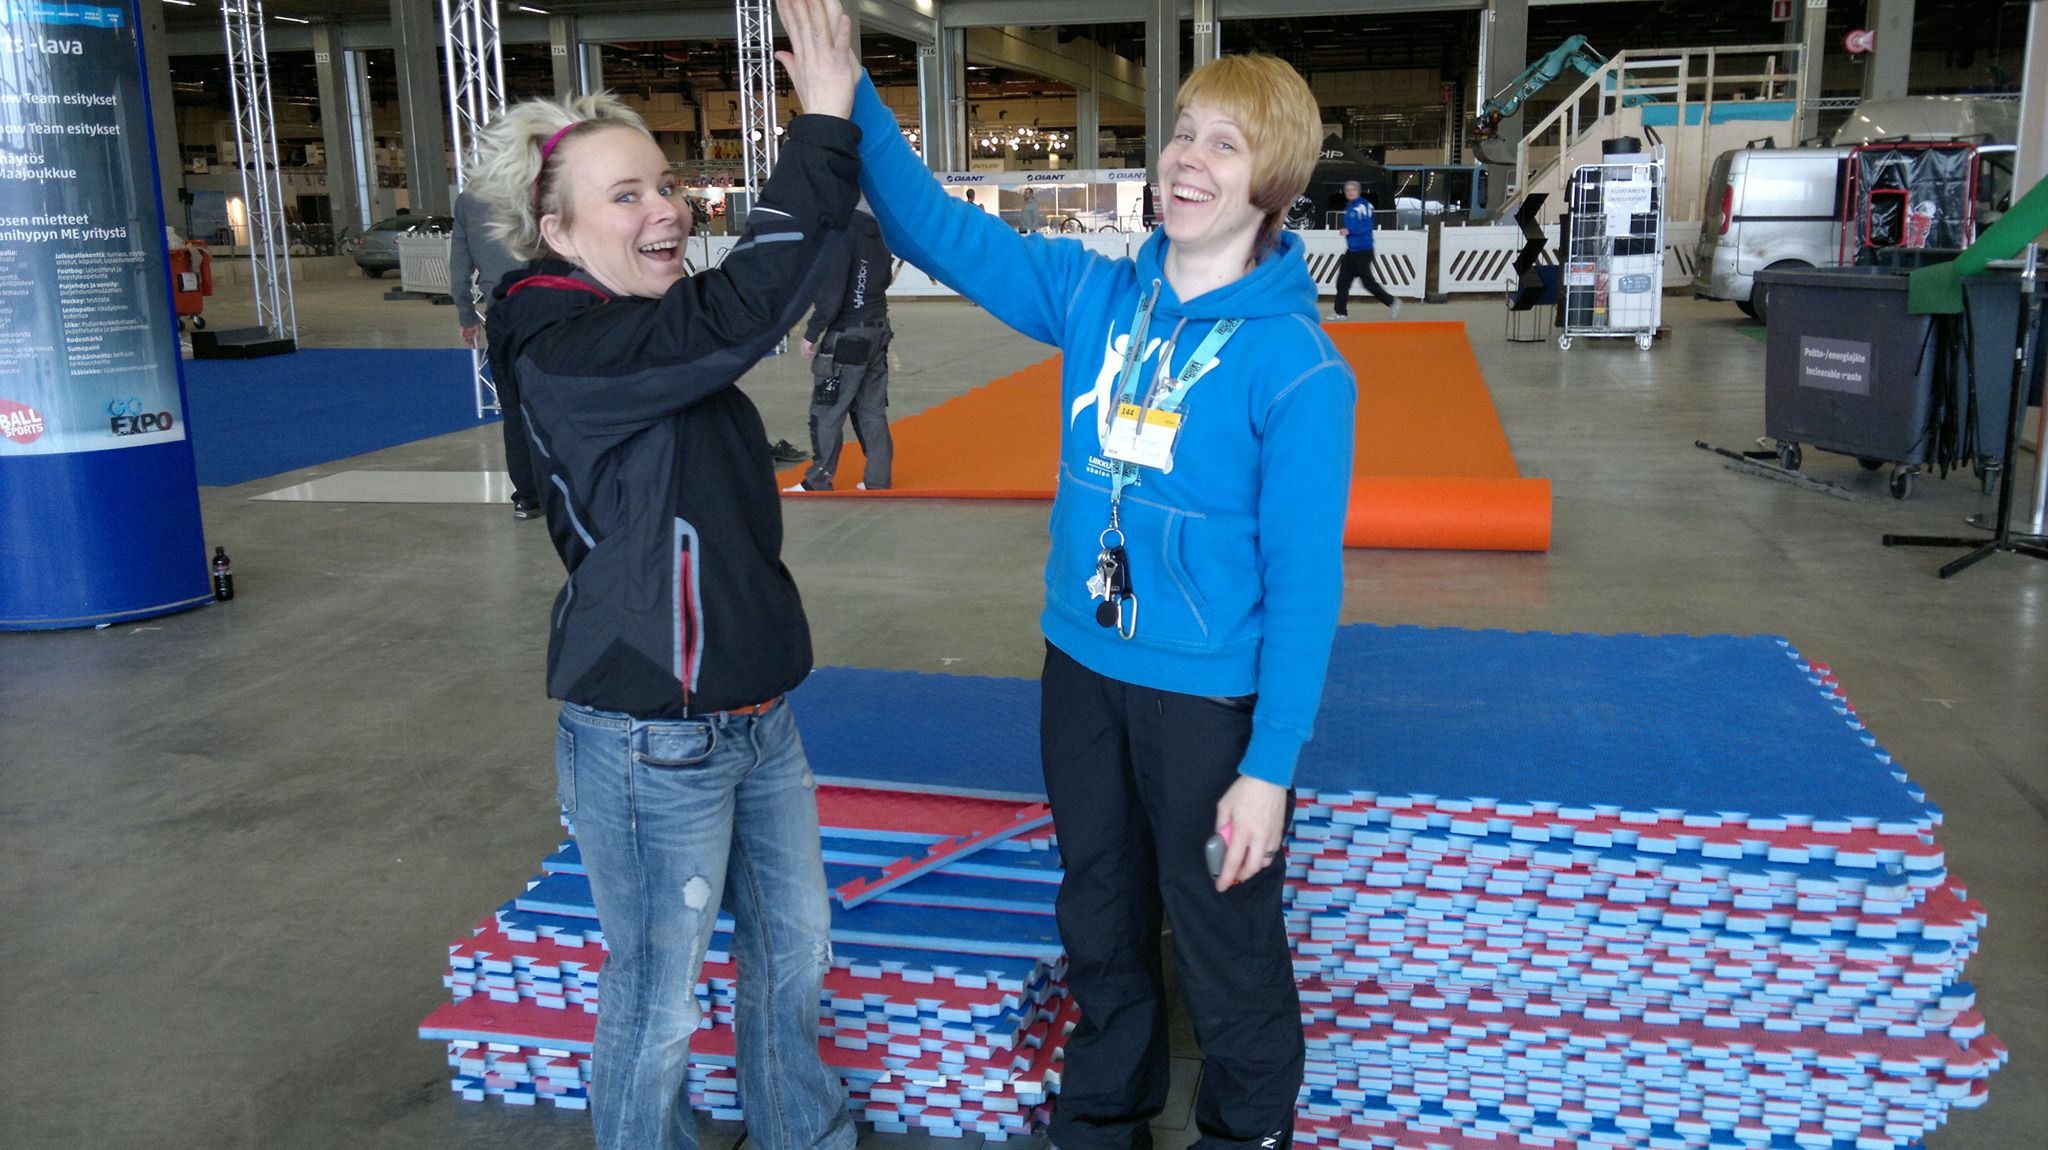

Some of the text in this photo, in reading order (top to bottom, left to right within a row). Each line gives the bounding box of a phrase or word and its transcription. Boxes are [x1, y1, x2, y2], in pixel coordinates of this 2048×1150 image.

[1196, 24, 1211, 32] 718
[30, 35, 83, 55] -lava
[922, 48, 936, 56] 716
[24, 92, 60, 104] Team
[63, 92, 118, 107] esitykset
[29, 122, 64, 134] Team
[67, 122, 121, 136] esitykset
[1034, 174, 1066, 182] GIANT
[32, 213, 89, 225] mietteet
[61, 229, 80, 239] ME
[82, 227, 127, 241] yritystä
[1806, 366, 1840, 379] Incinerable
[103, 398, 143, 416] GO
[1121, 407, 1134, 417] 144
[0, 409, 41, 430] BALL
[111, 411, 173, 435] EXPO
[5, 423, 44, 438] SPORTS
